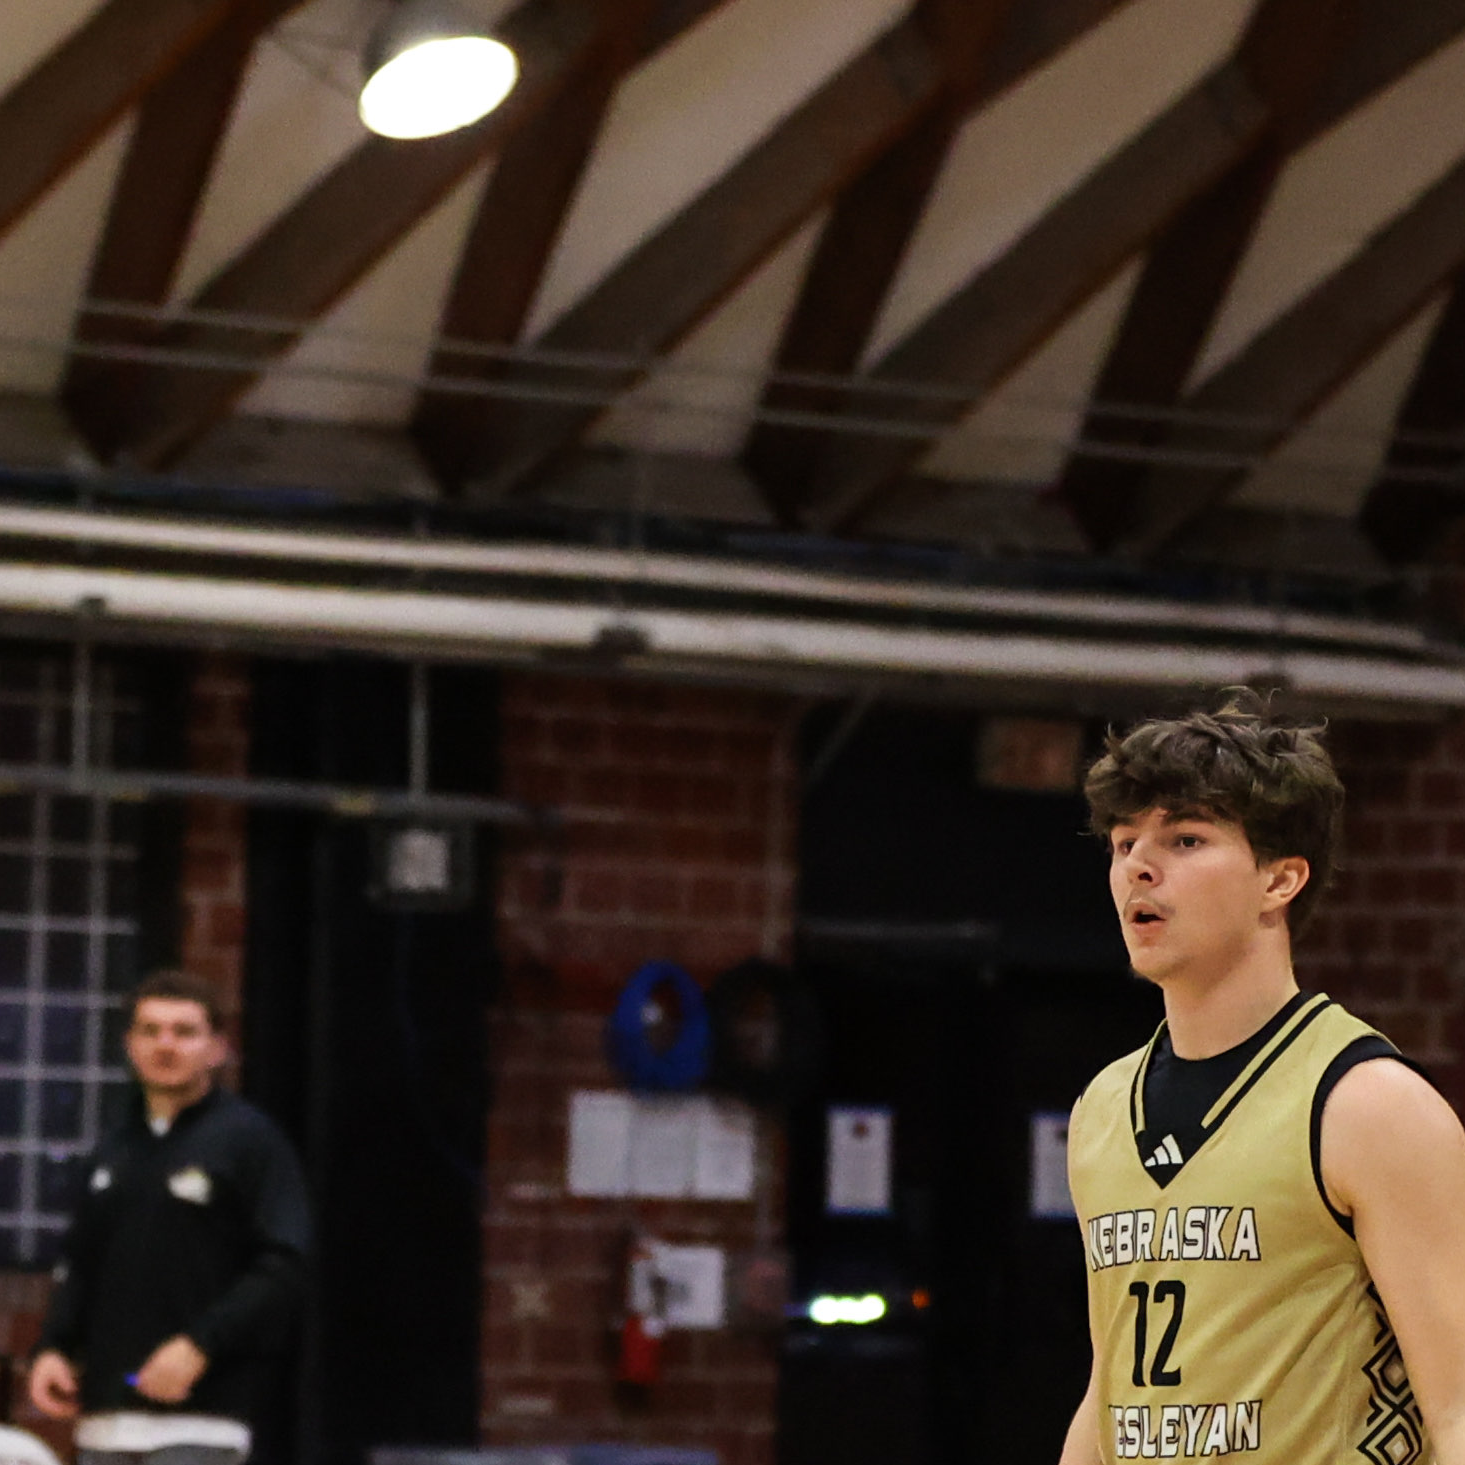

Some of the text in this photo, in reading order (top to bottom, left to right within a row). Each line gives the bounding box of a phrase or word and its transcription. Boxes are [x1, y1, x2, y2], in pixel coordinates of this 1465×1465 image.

[1088, 1206, 1262, 1272] NEBRASKA
[1129, 1280, 1186, 1387] 12
[1108, 1399, 1263, 1459] ESLEYAN
